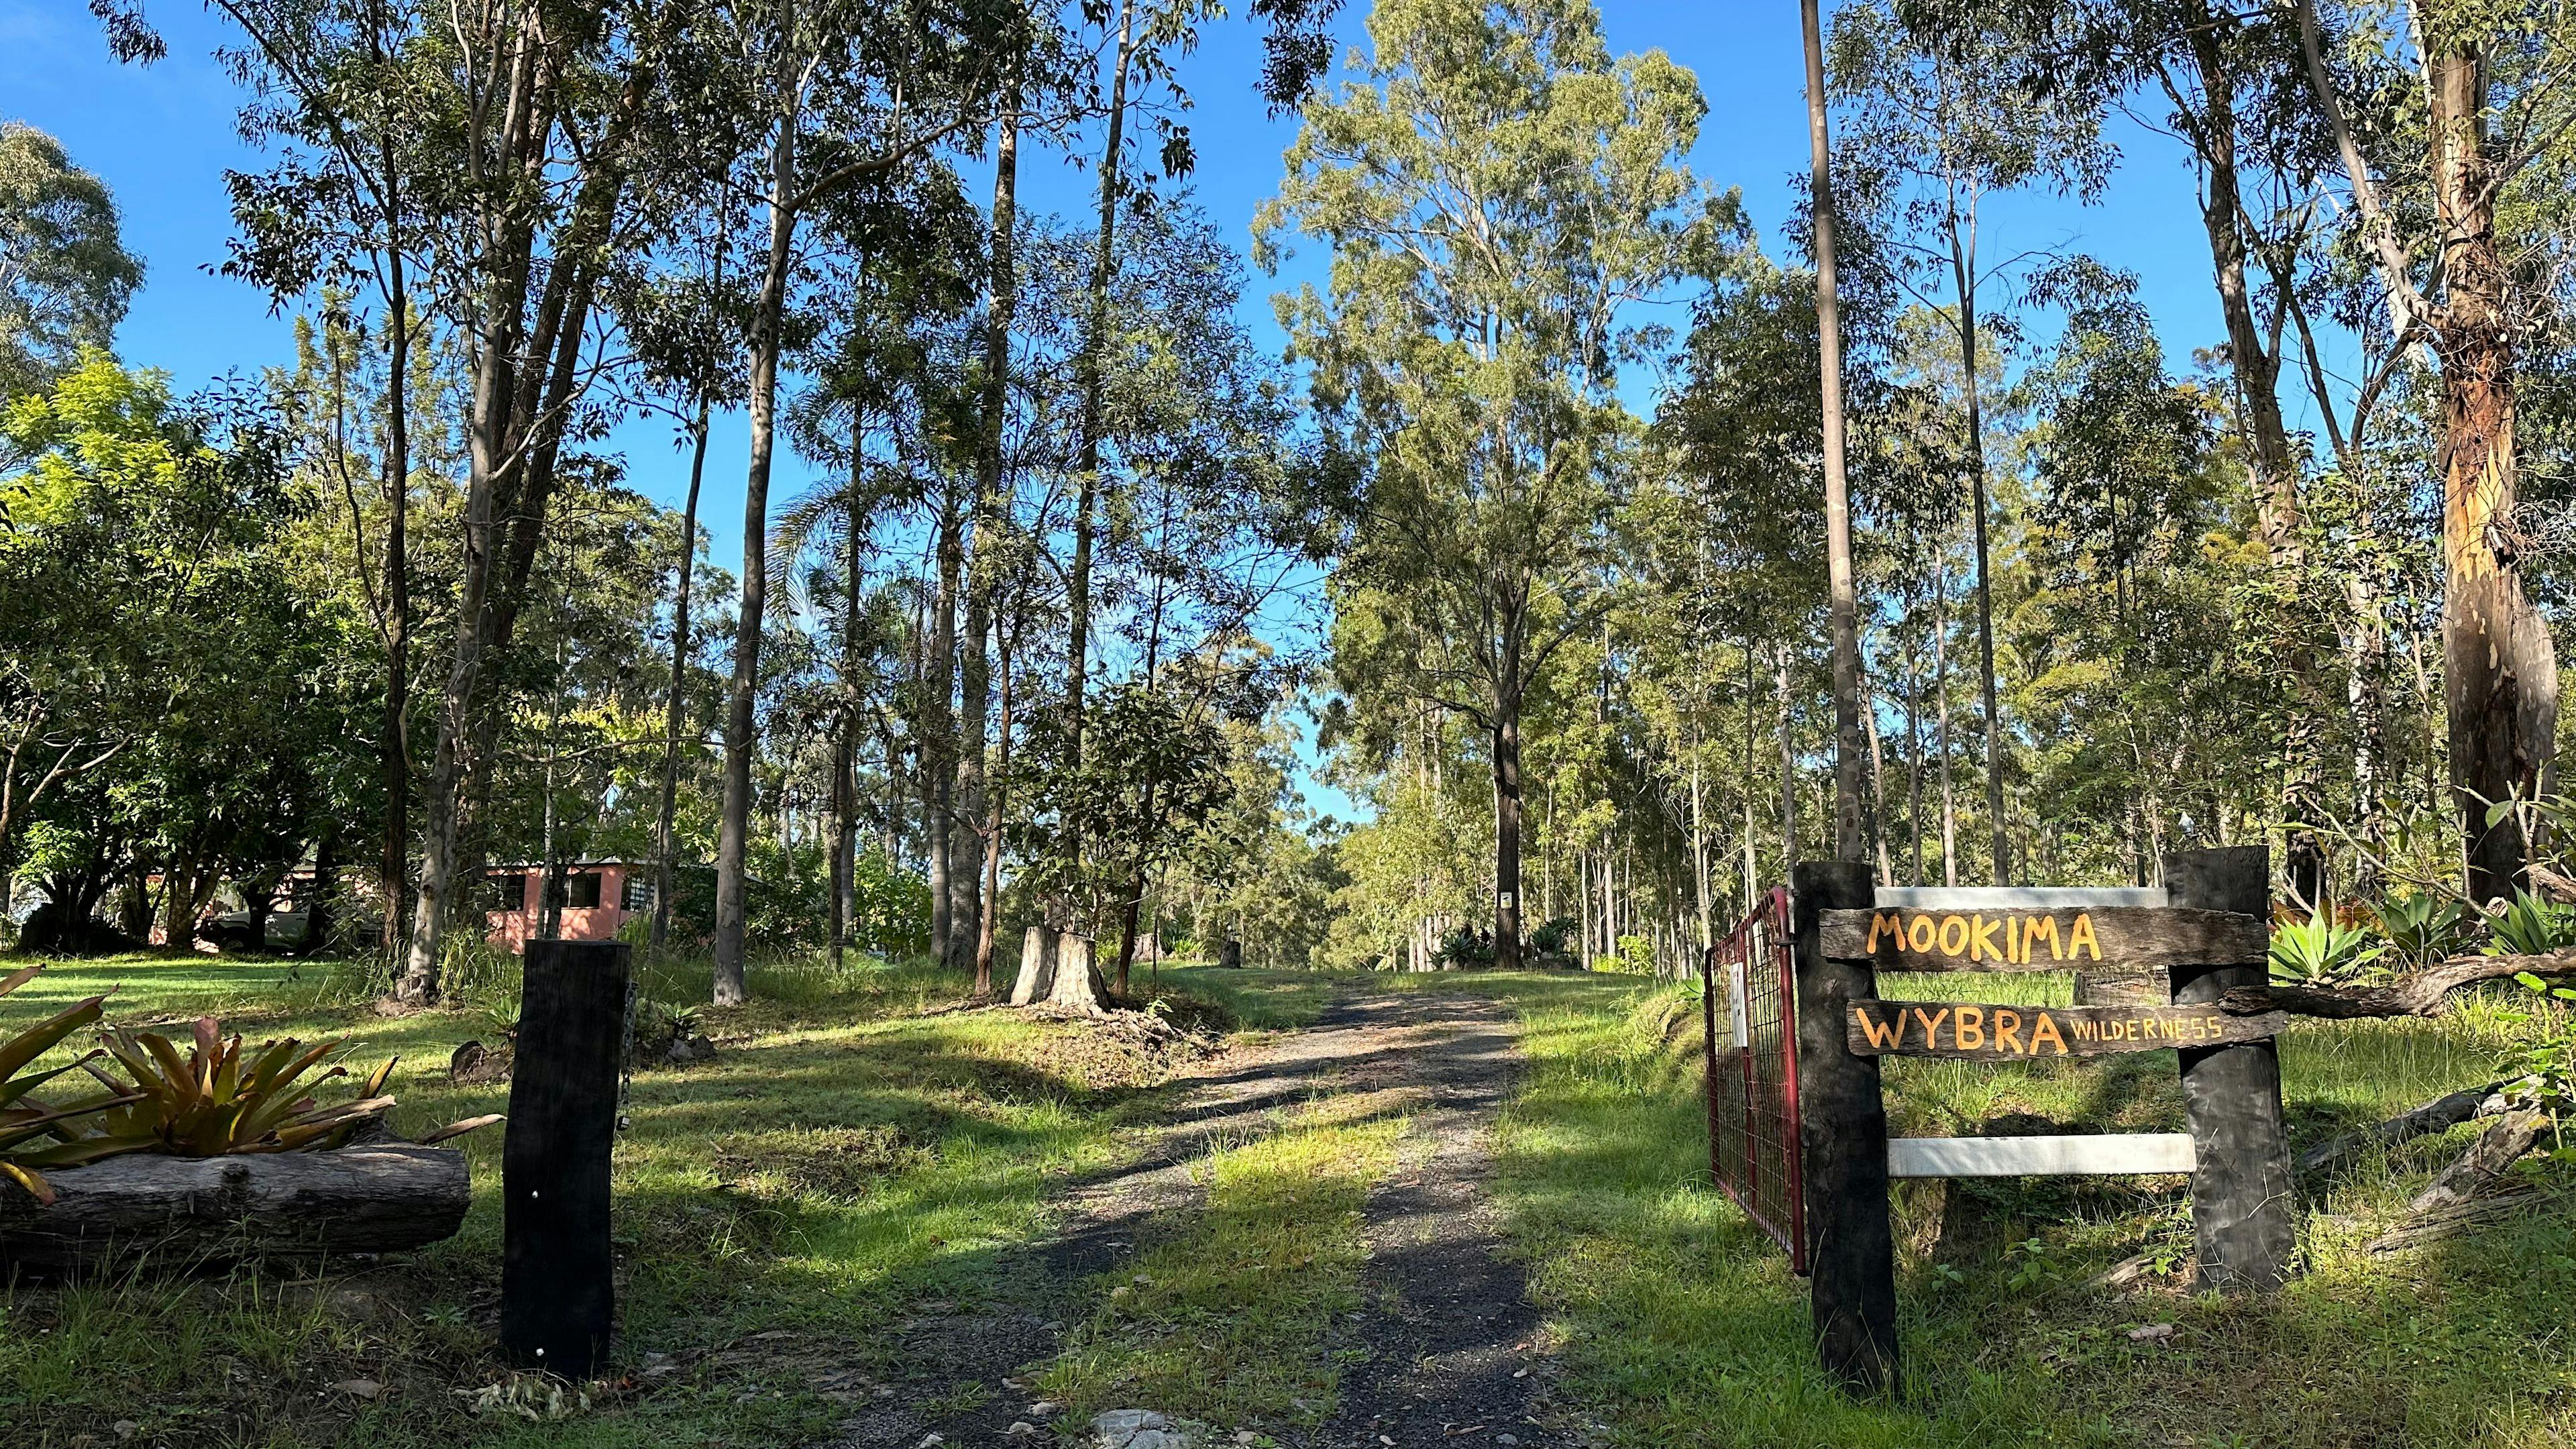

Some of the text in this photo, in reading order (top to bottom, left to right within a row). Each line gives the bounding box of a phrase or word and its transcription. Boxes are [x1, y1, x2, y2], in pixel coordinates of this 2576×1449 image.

[1866, 912, 2102, 964] MOOKIMA
[1856, 1006, 2222, 1055] WYBRA WILDERNESS
